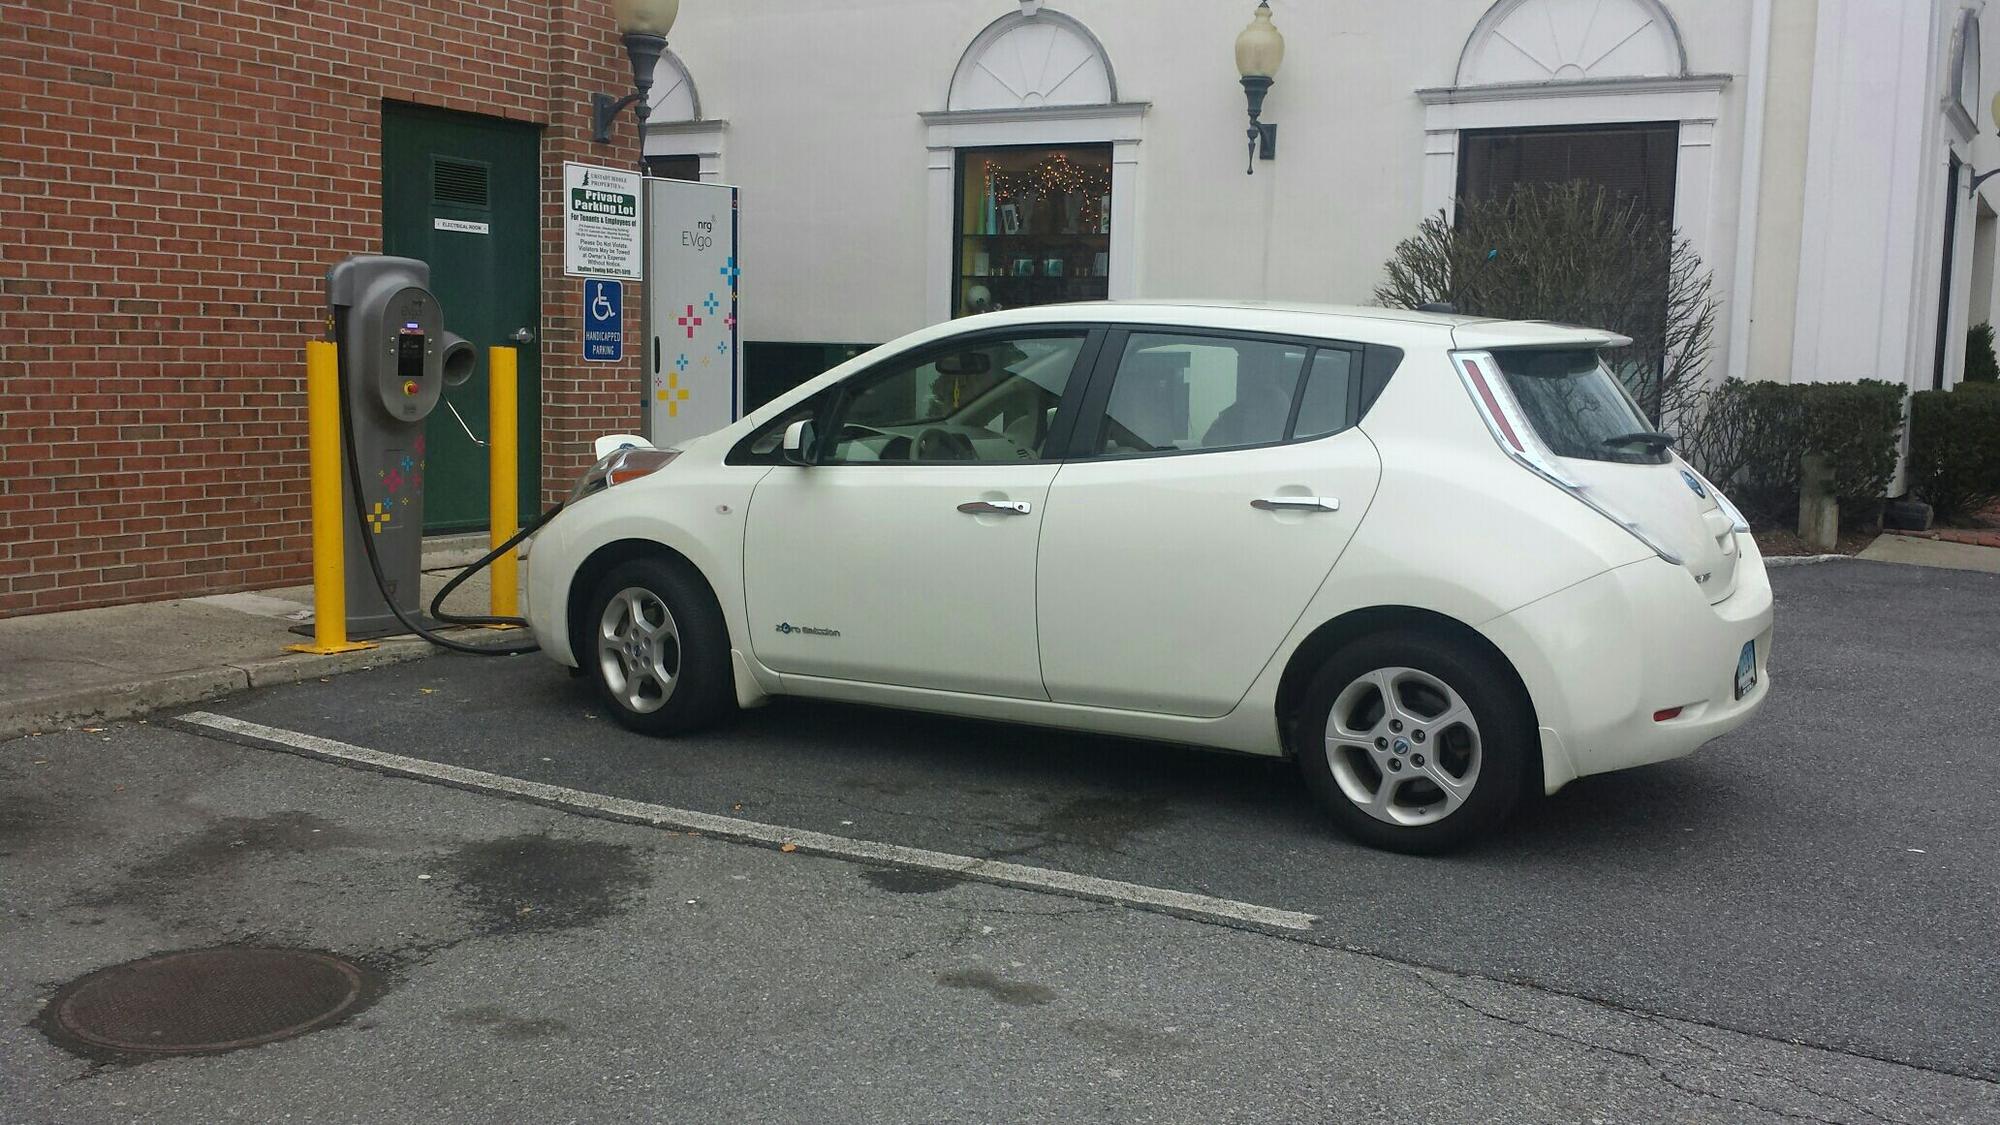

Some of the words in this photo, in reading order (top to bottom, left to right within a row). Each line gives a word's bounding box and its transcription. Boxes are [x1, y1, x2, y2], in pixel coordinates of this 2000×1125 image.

[585, 190, 624, 203] Private
[574, 200, 617, 214] Parking
[618, 205, 634, 215] Lot
[580, 213, 600, 223] Tenants
[605, 217, 631, 226] Employees
[698, 221, 712, 233] nrg
[682, 231, 713, 251] EVgo
[586, 331, 620, 341] HANDICAPPED
[592, 345, 614, 355] PARKING
